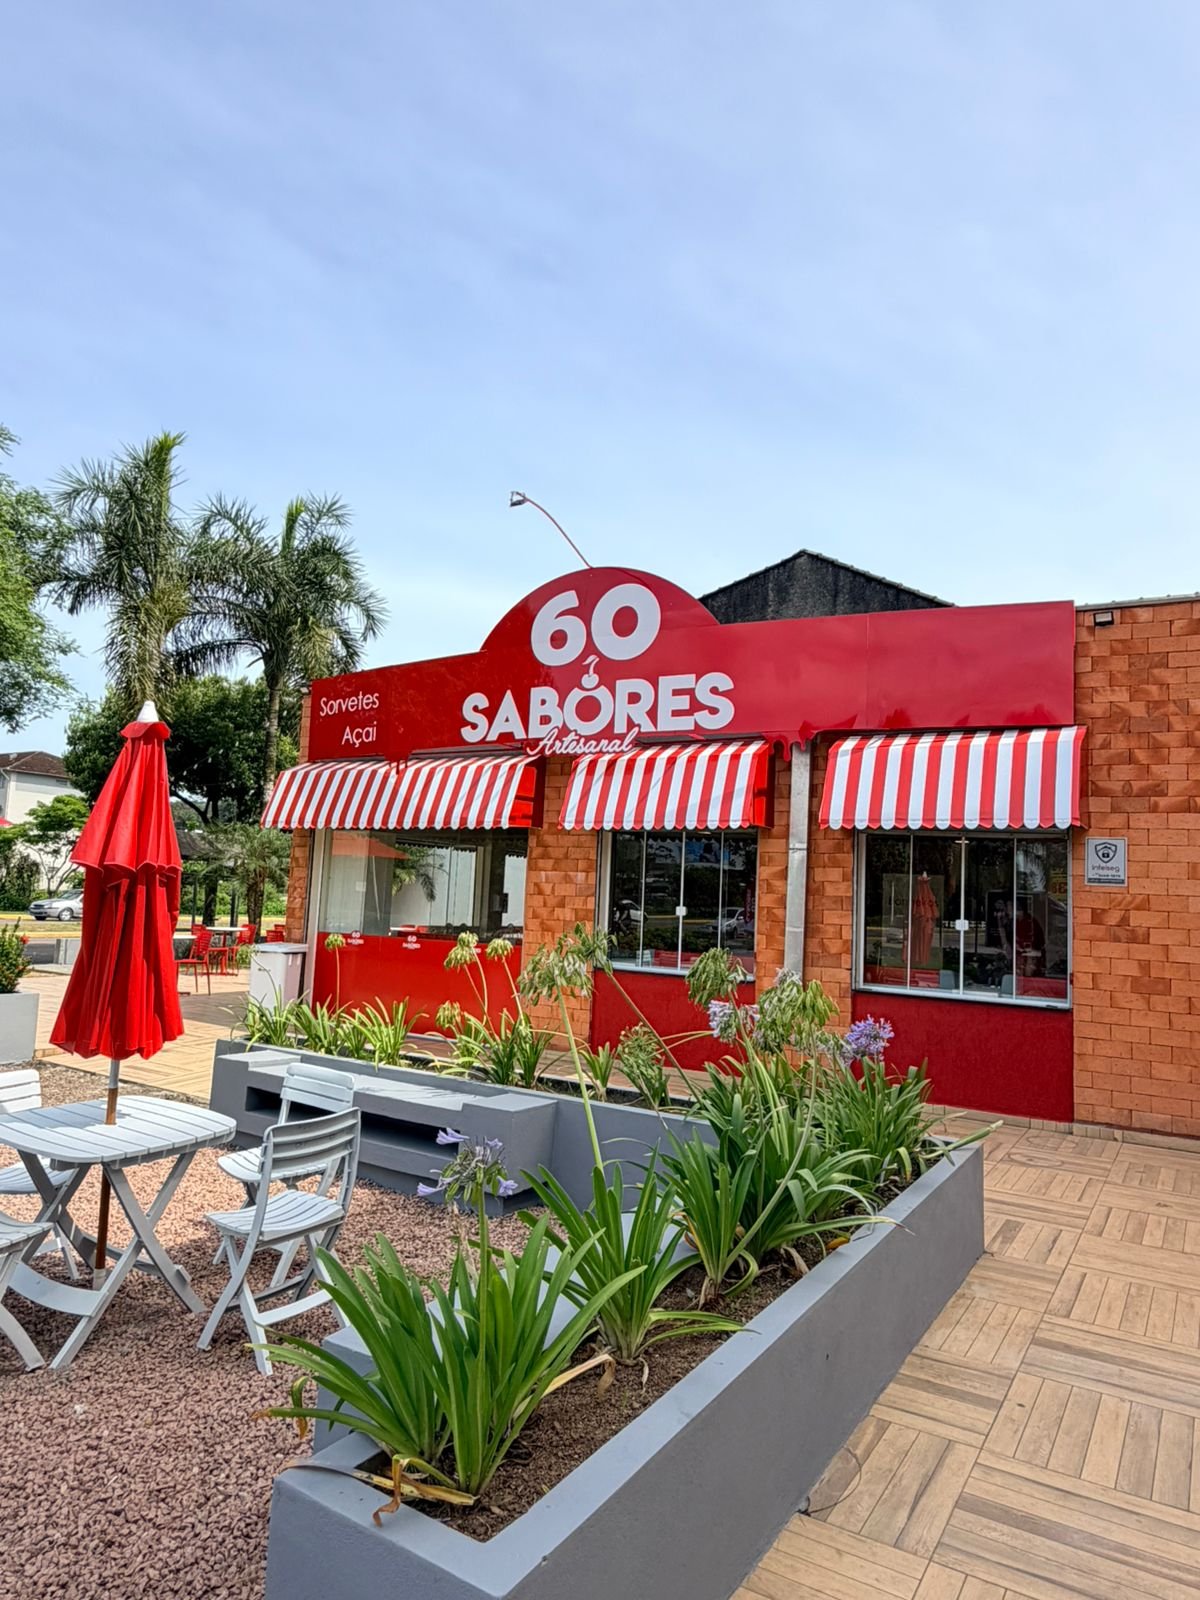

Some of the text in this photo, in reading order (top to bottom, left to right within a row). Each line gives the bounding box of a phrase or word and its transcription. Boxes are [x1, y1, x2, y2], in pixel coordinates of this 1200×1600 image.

[531, 583, 661, 667] 60
[320, 691, 380, 717] Sorvetes
[460, 671, 736, 743] SABORES
[341, 721, 378, 748] Açai
[526, 726, 640, 755] Artesanal
